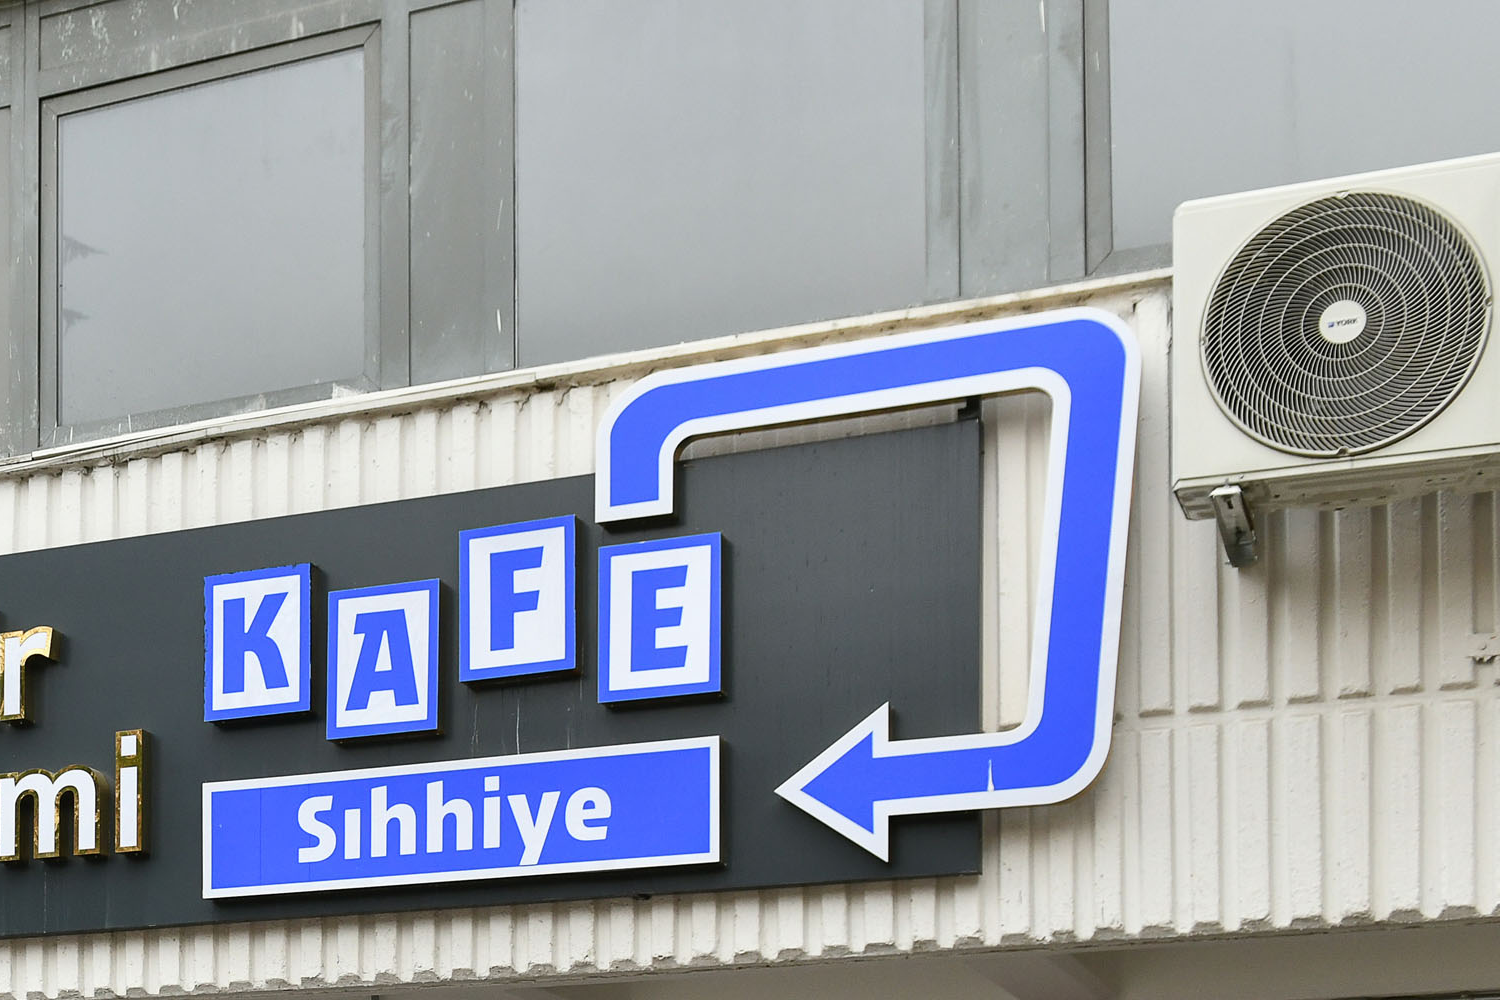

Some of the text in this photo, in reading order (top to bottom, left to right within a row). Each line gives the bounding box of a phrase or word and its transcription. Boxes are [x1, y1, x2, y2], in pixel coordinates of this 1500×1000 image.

[1336, 318, 1357, 326] YORK
[222, 545, 689, 712] KAFE
[297, 775, 612, 866] Sıhhiye
